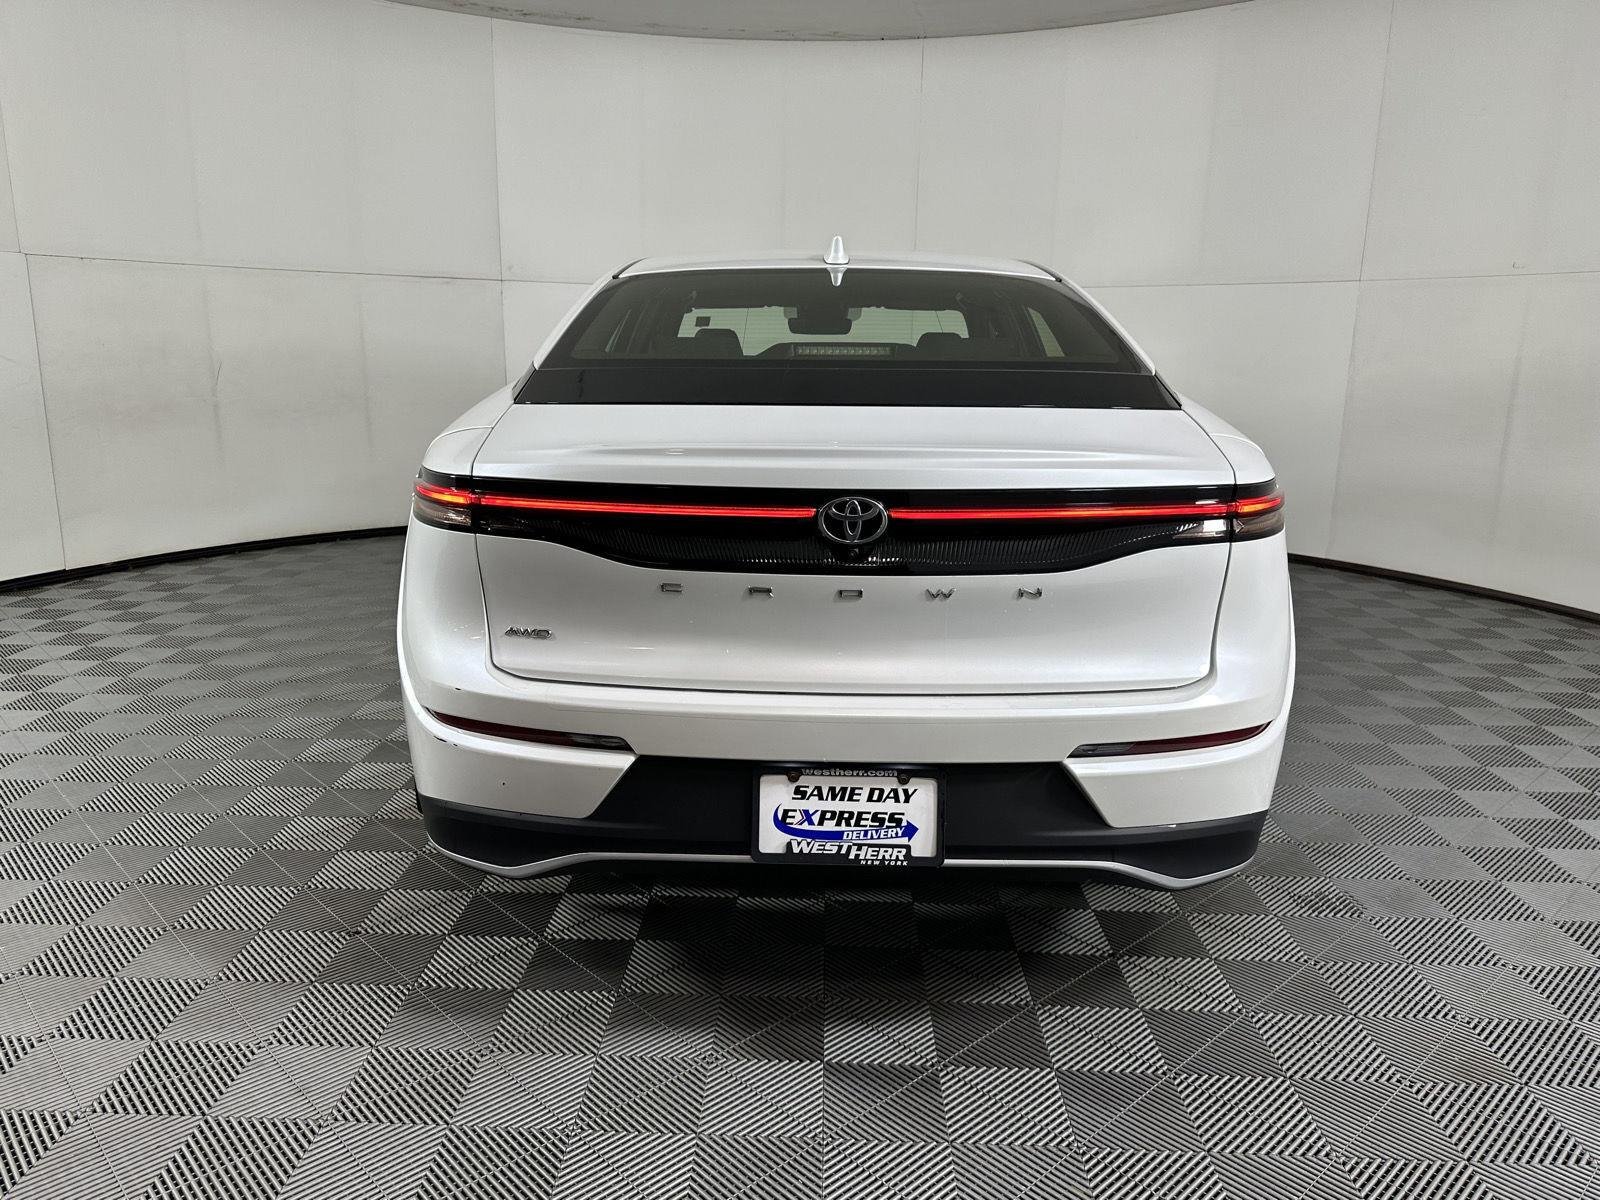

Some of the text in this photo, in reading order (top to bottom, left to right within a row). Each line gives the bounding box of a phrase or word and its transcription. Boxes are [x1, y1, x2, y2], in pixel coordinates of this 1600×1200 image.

[504, 626, 552, 640] AWD
[792, 785, 918, 804] SAME DAY
[781, 808, 905, 829] EXPRESS
[843, 826, 906, 840] DELIVERY
